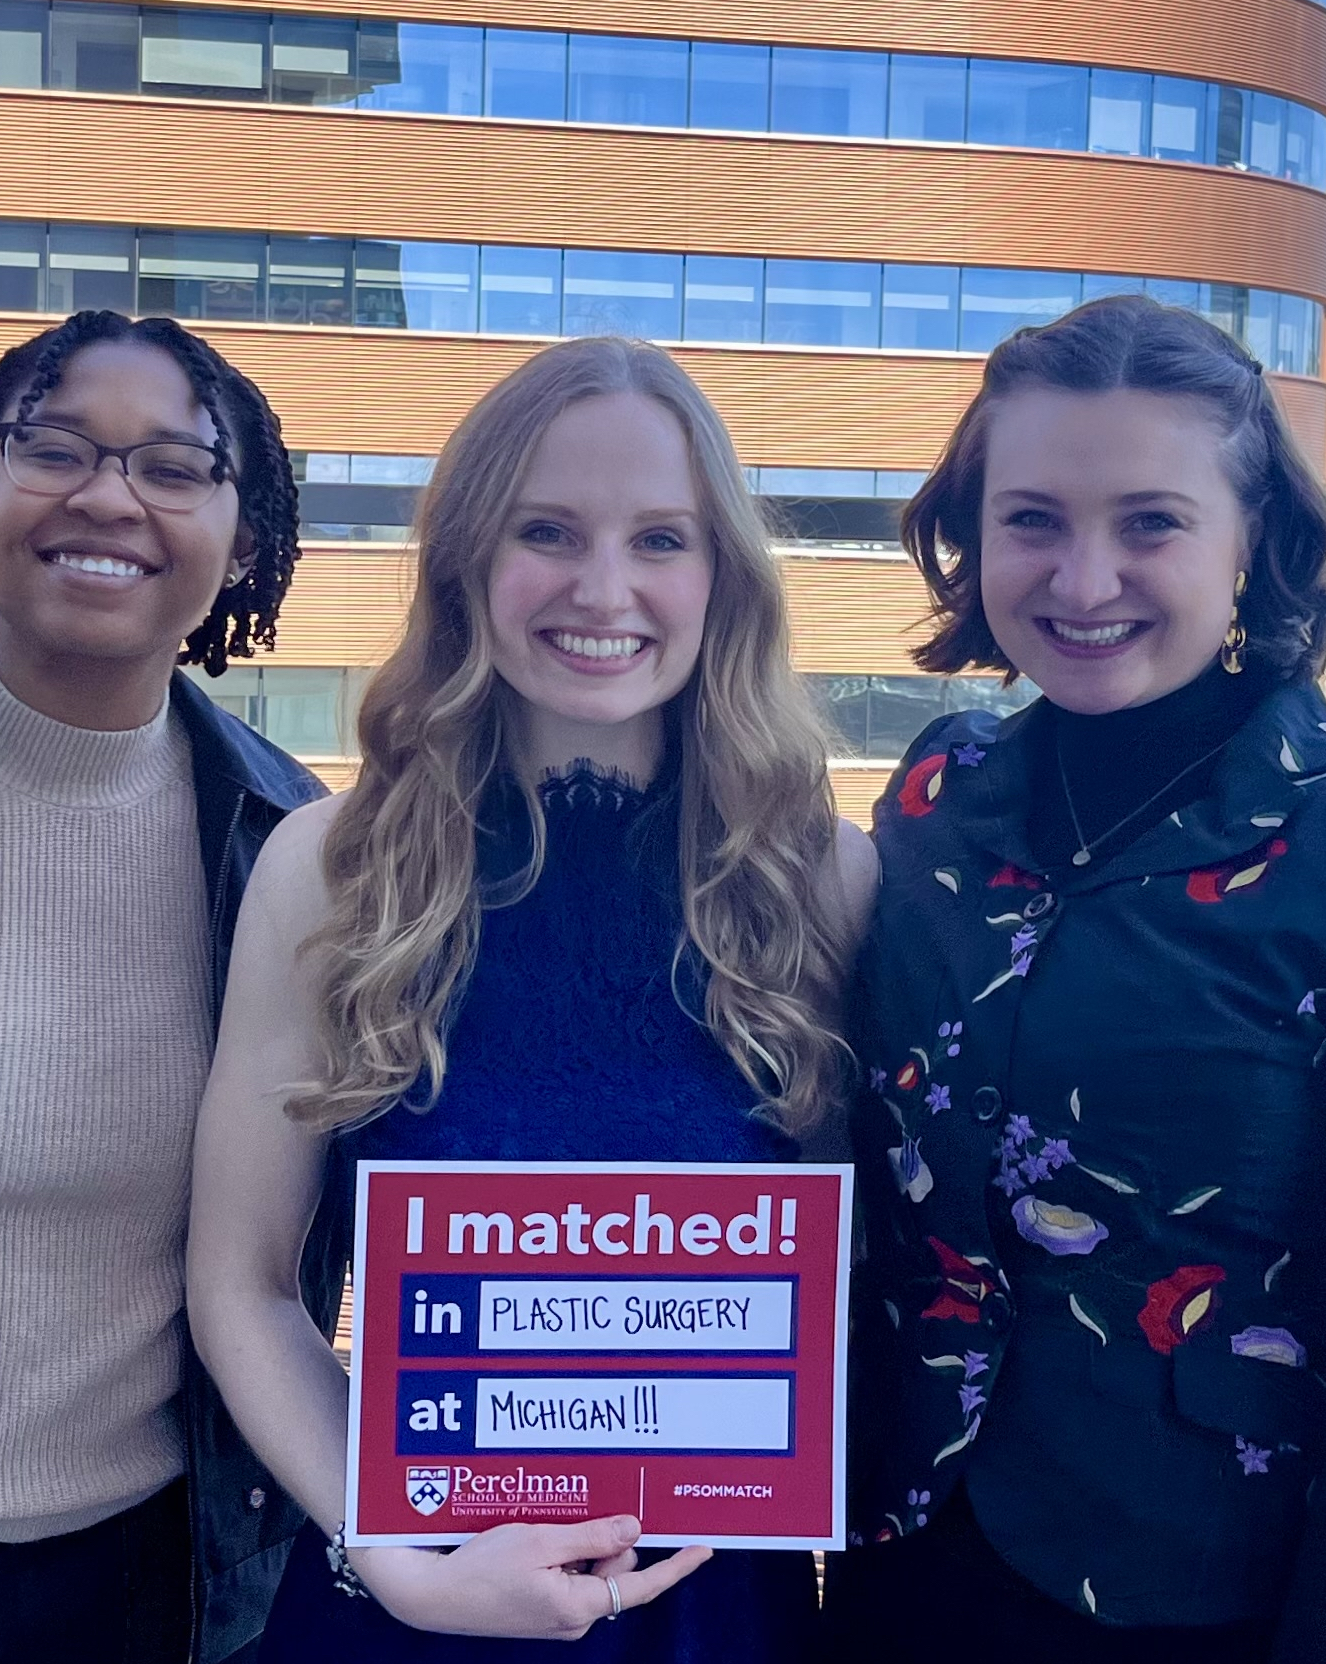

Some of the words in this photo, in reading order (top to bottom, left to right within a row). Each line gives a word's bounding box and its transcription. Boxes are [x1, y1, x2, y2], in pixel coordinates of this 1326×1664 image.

[406, 1196, 424, 1254] I
[447, 1193, 797, 1256] matched!
[414, 1289, 462, 1334] in
[492, 1295, 612, 1333] PLASTIC
[624, 1296, 751, 1335] SURGERY
[408, 1392, 462, 1432] at
[490, 1384, 659, 1435] MICHIGAN!!!
[451, 1492, 502, 1503] SCHOOL
[506, 1492, 522, 1503] OF
[527, 1492, 588, 1503] MEDICINE
[453, 1466, 589, 1493] Perelman
[673, 1484, 773, 1498] #PSOMMATCH
[508, 1506, 519, 1517] of
